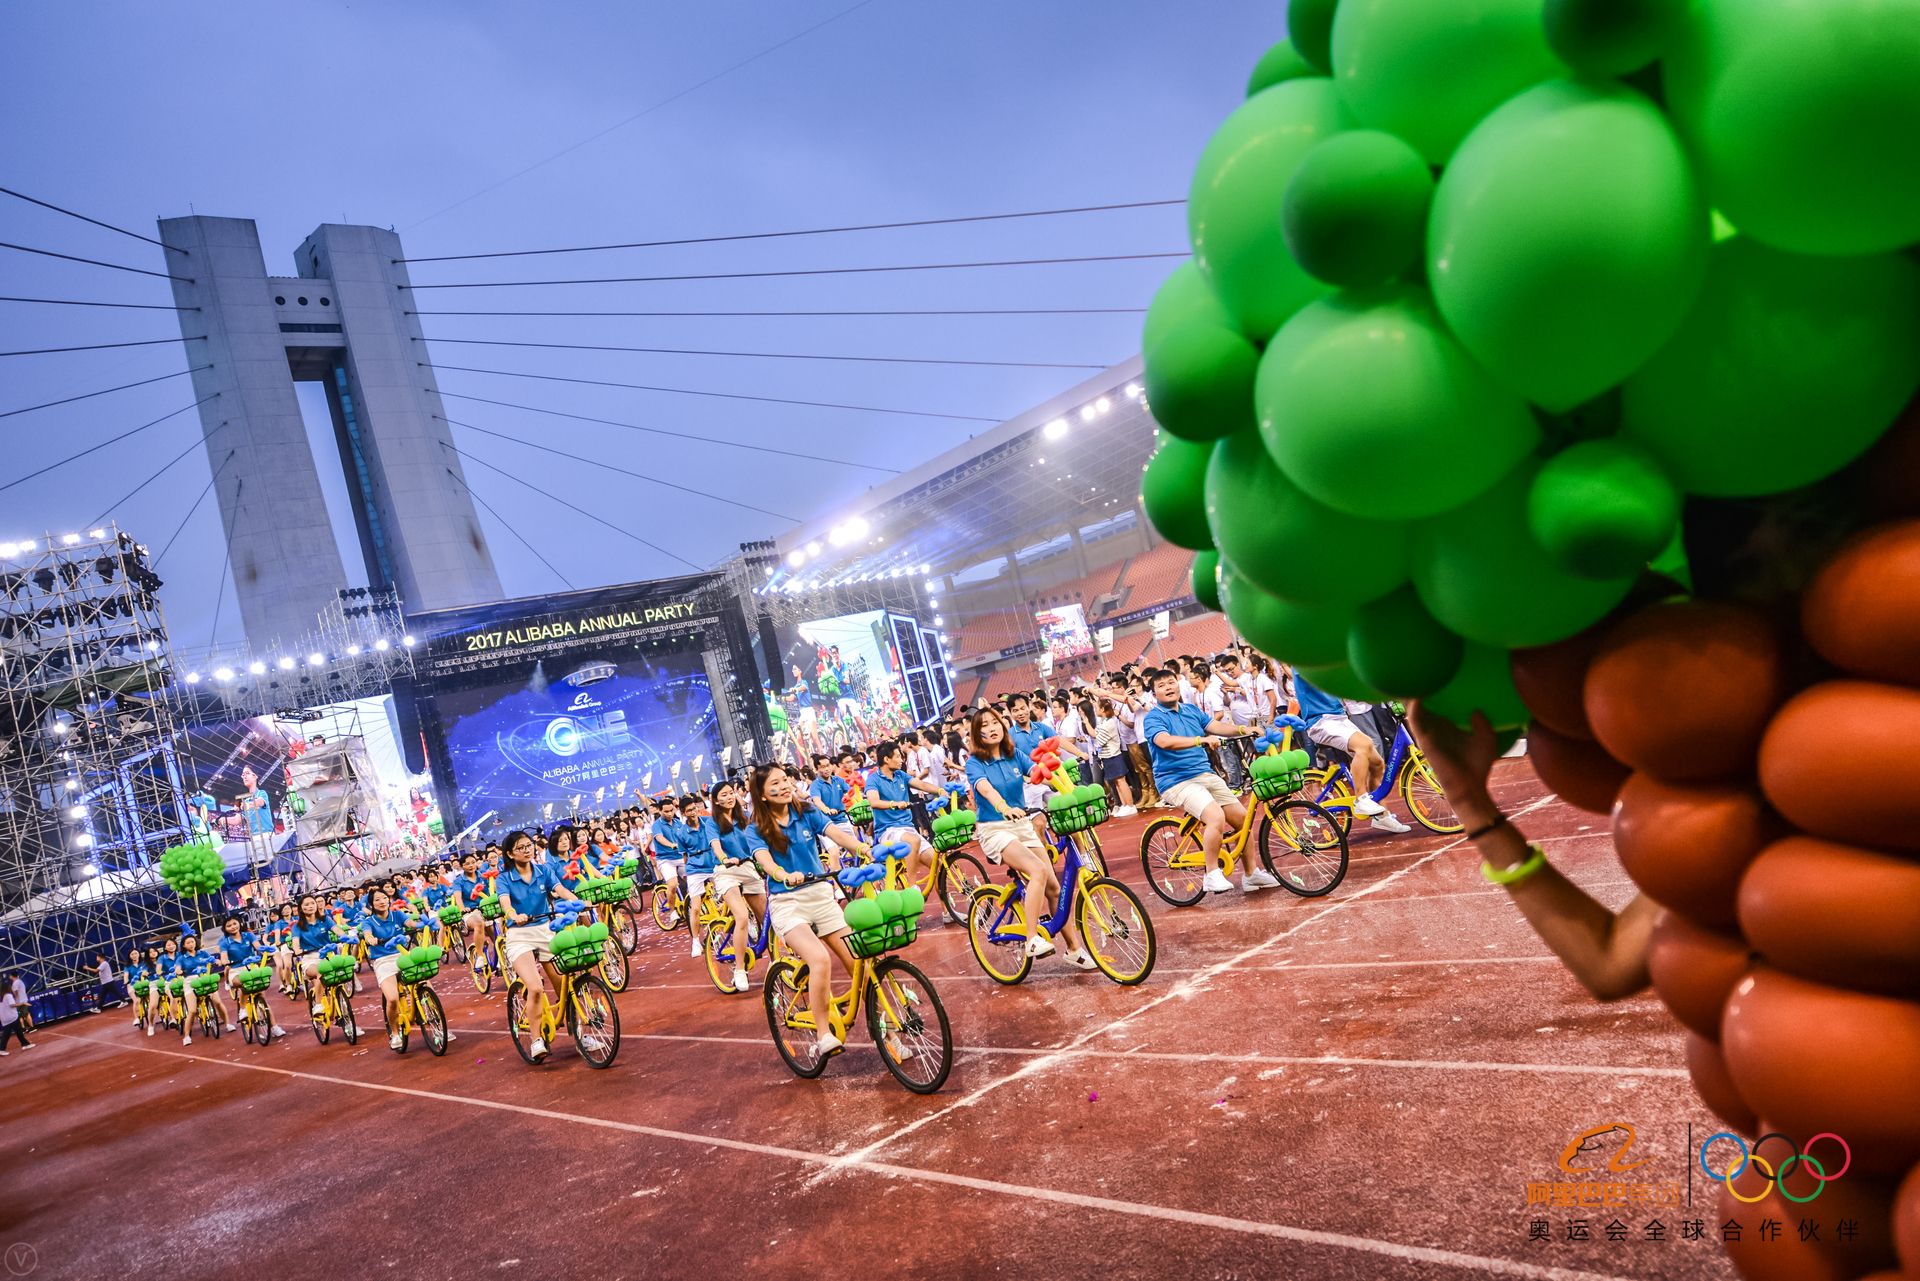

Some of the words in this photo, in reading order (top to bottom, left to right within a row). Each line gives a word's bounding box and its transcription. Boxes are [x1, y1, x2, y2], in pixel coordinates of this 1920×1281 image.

[466, 632, 503, 651] 2017
[505, 622, 576, 645] ALIBABA
[579, 612, 643, 634] ANNUAL
[645, 602, 695, 623] PARTY
[545, 709, 631, 757] ONE
[542, 764, 580, 779] ALIBABA
[582, 756, 617, 770] ANNUAL
